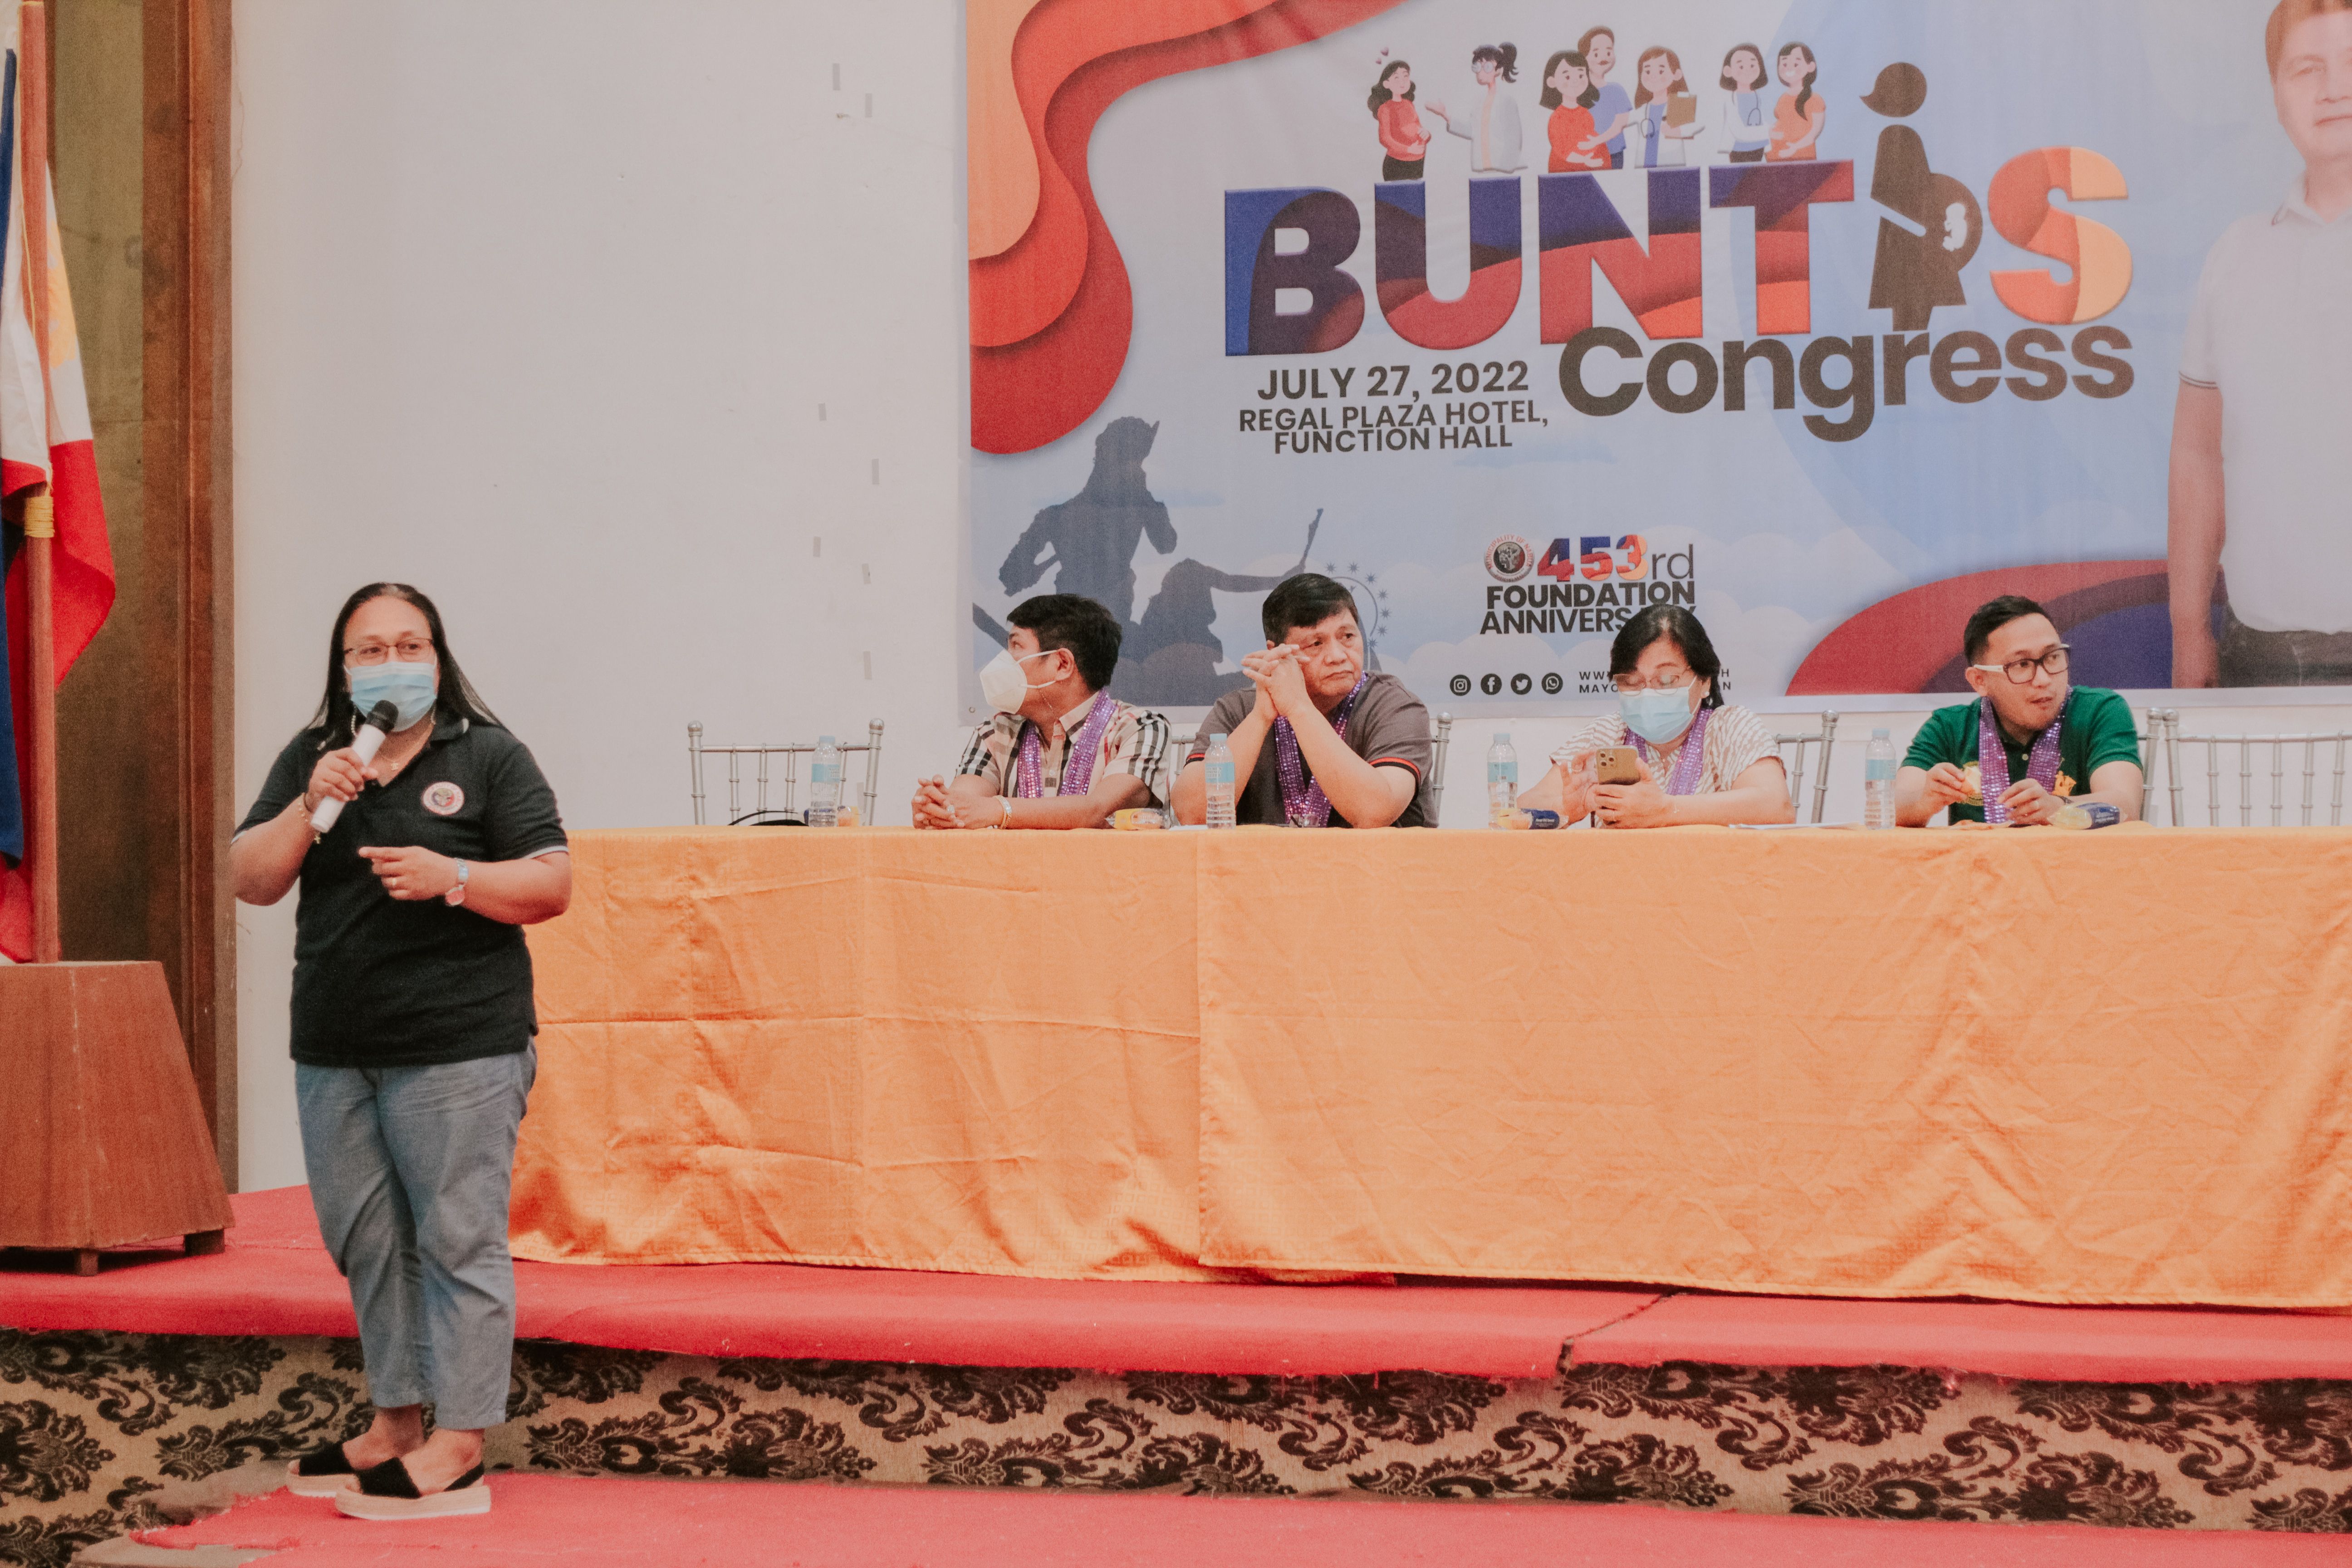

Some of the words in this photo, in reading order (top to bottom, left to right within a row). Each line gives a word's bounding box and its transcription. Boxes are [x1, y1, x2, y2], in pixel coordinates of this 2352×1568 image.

[1257, 367, 1356, 400] JULY
[1367, 365, 1420, 402] 27,
[1431, 361, 1529, 395] 2022
[1559, 325, 2135, 442] Congress
[1240, 408, 1333, 431] REGAL
[1342, 404, 1437, 428] PLAZA
[1446, 400, 1548, 427] HOTEL,
[1275, 427, 1430, 454] FUNCTION
[1440, 425, 1513, 449] HALL
[1487, 581, 1695, 609] FOUNDATION
[1480, 606, 1697, 634] ANNIVERS
